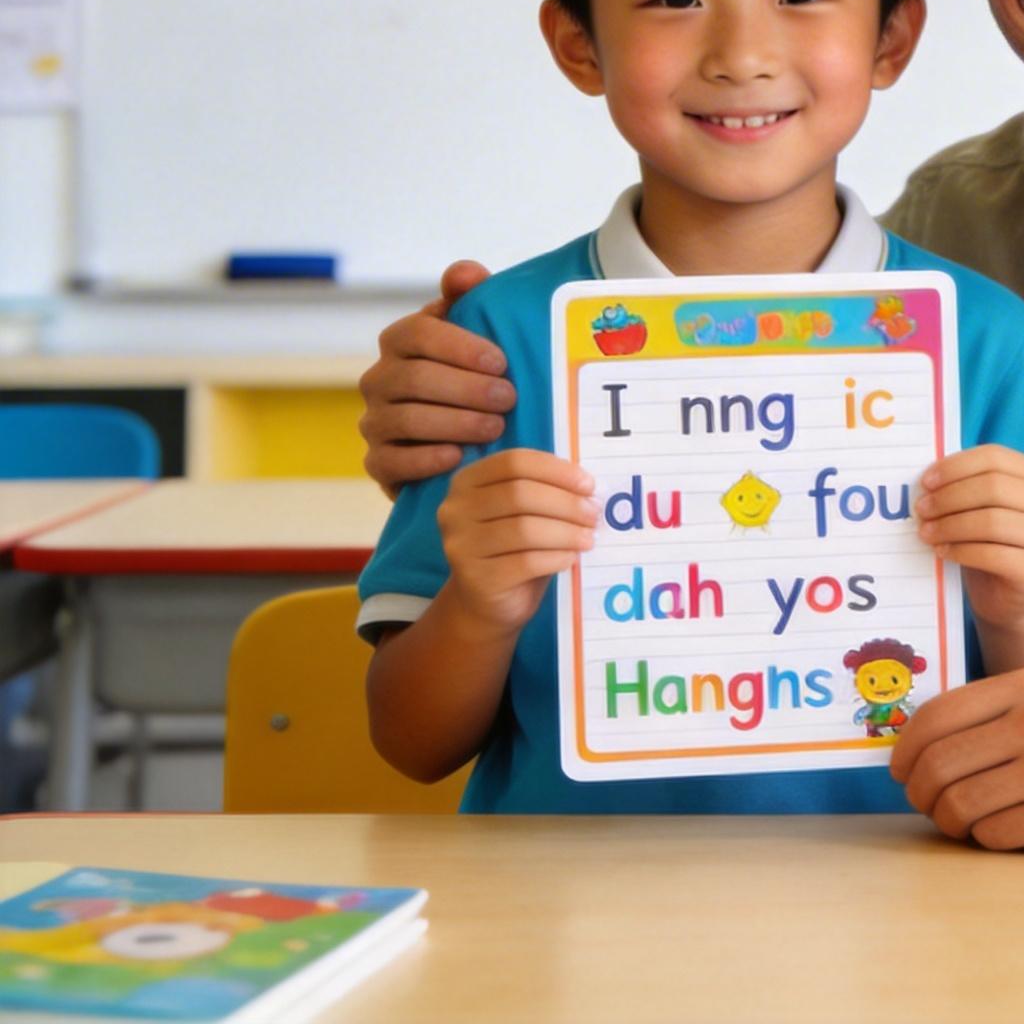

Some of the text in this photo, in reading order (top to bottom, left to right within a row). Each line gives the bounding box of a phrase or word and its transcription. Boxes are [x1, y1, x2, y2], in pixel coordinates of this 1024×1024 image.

[602, 377, 896, 452] I nng ic
[604, 466, 912, 538] du fou
[603, 562, 877, 636] dah yos
